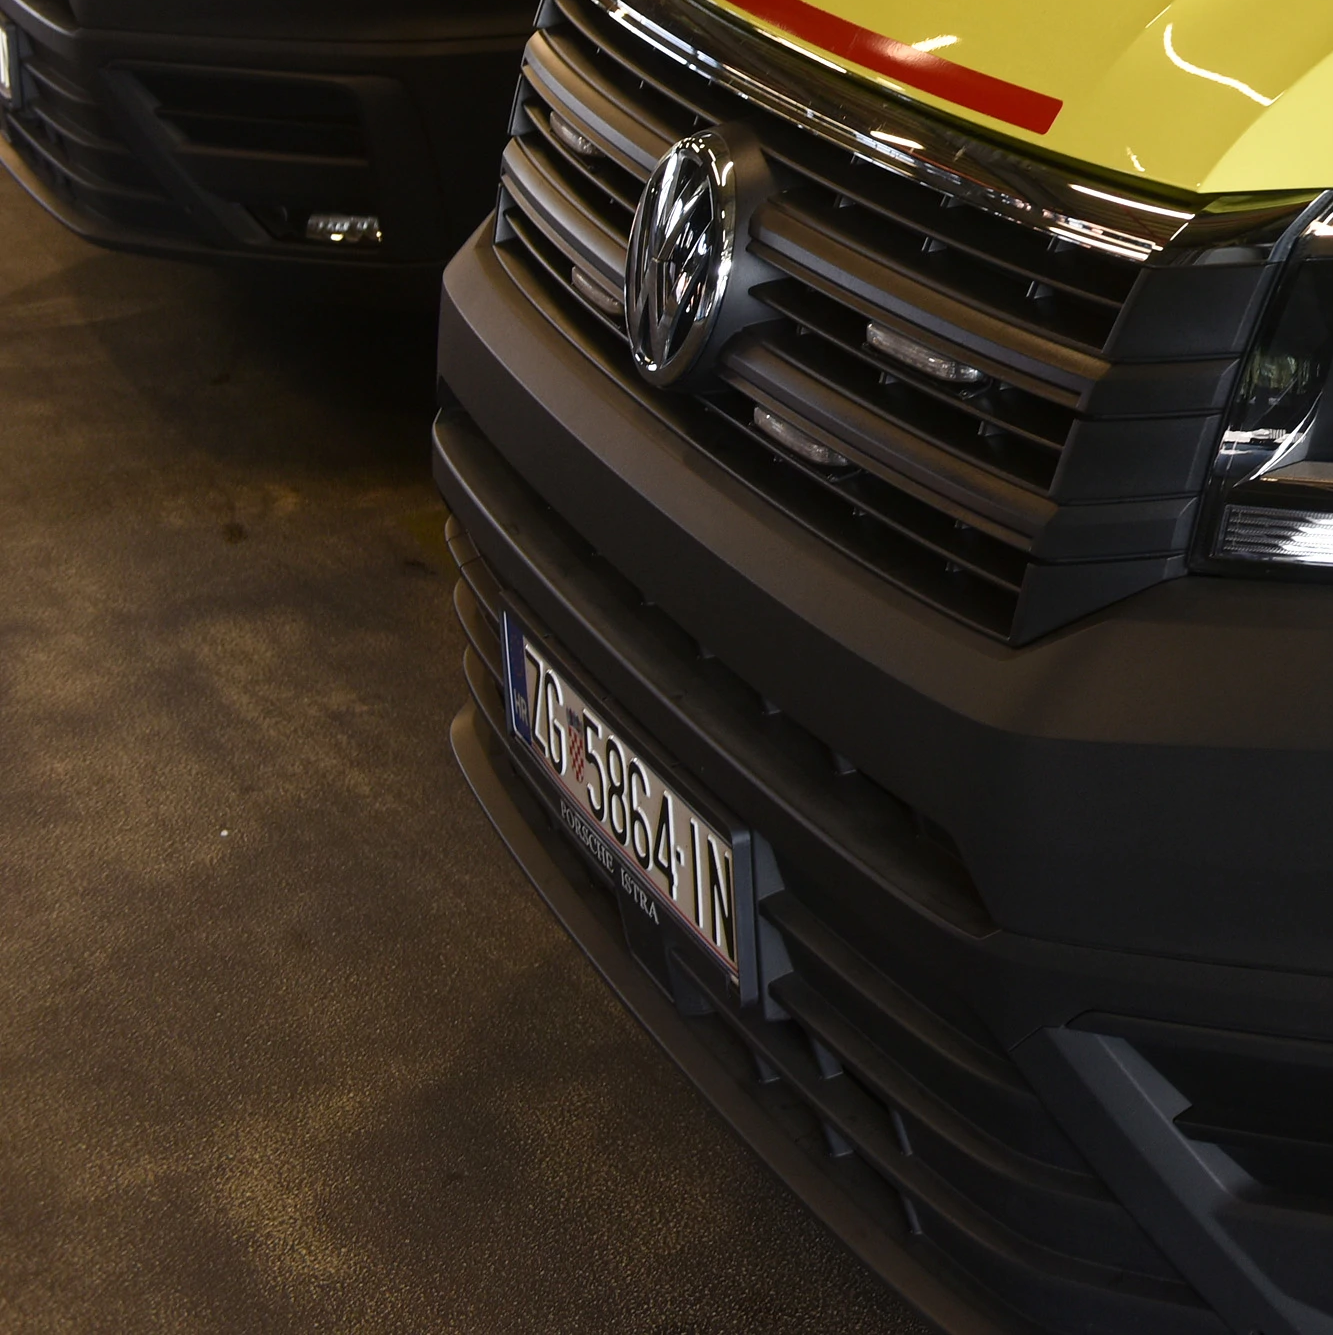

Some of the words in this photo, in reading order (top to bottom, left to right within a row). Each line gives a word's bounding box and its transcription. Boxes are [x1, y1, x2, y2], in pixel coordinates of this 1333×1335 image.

[513, 687, 529, 727] HR
[524, 643, 567, 777] ZG
[560, 800, 615, 874] PORSCHE
[620, 867, 660, 926] ISTRA
